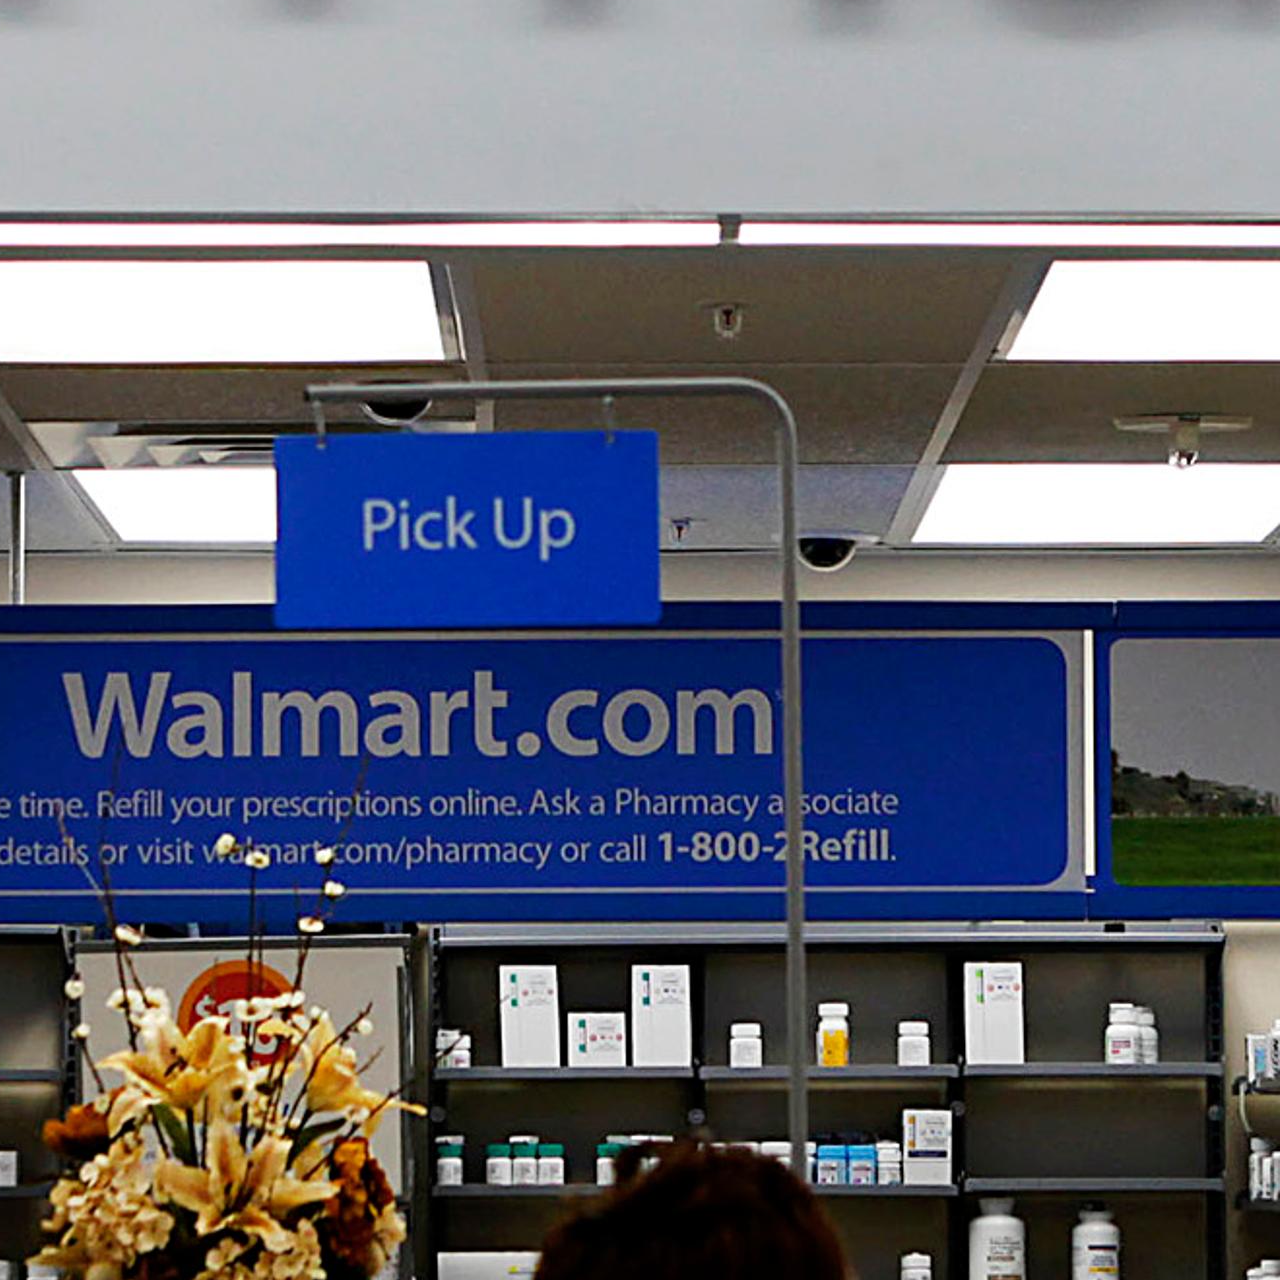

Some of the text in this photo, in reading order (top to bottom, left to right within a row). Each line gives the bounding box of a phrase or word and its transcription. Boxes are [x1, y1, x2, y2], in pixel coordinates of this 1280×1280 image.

[362, 495, 576, 562] Pick Up
[62, 670, 773, 759] Walmart.com
[19, 791, 89, 819] time.
[97, 789, 163, 818] Refill
[170, 796, 235, 824] your
[243, 789, 423, 824] prescriptions
[429, 789, 522, 817] online.
[529, 789, 581, 816] Ask
[589, 795, 606, 816] a
[615, 788, 759, 822] Pharmacy
[101, 844, 129, 865] or
[137, 837, 194, 865] visit
[560, 842, 591, 863] or
[599, 834, 646, 862] call
